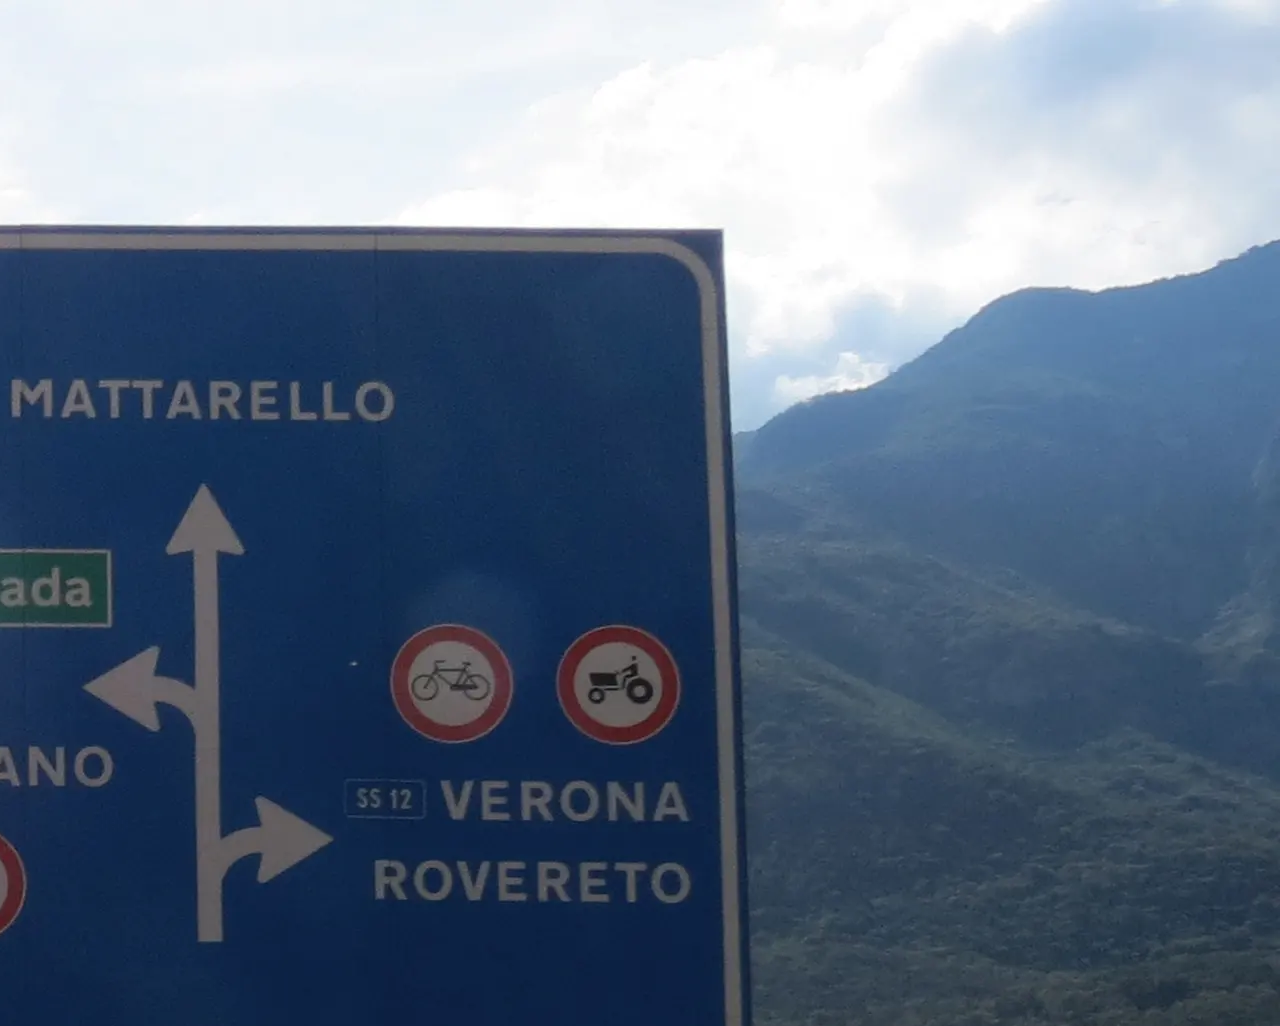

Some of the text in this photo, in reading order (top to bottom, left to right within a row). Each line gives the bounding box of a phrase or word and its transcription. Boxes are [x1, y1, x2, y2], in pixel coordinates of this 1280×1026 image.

[11, 378, 395, 422] MATTARELLO
[357, 779, 690, 822] SS 12 VERONA
[374, 859, 691, 904] ROVERETO
